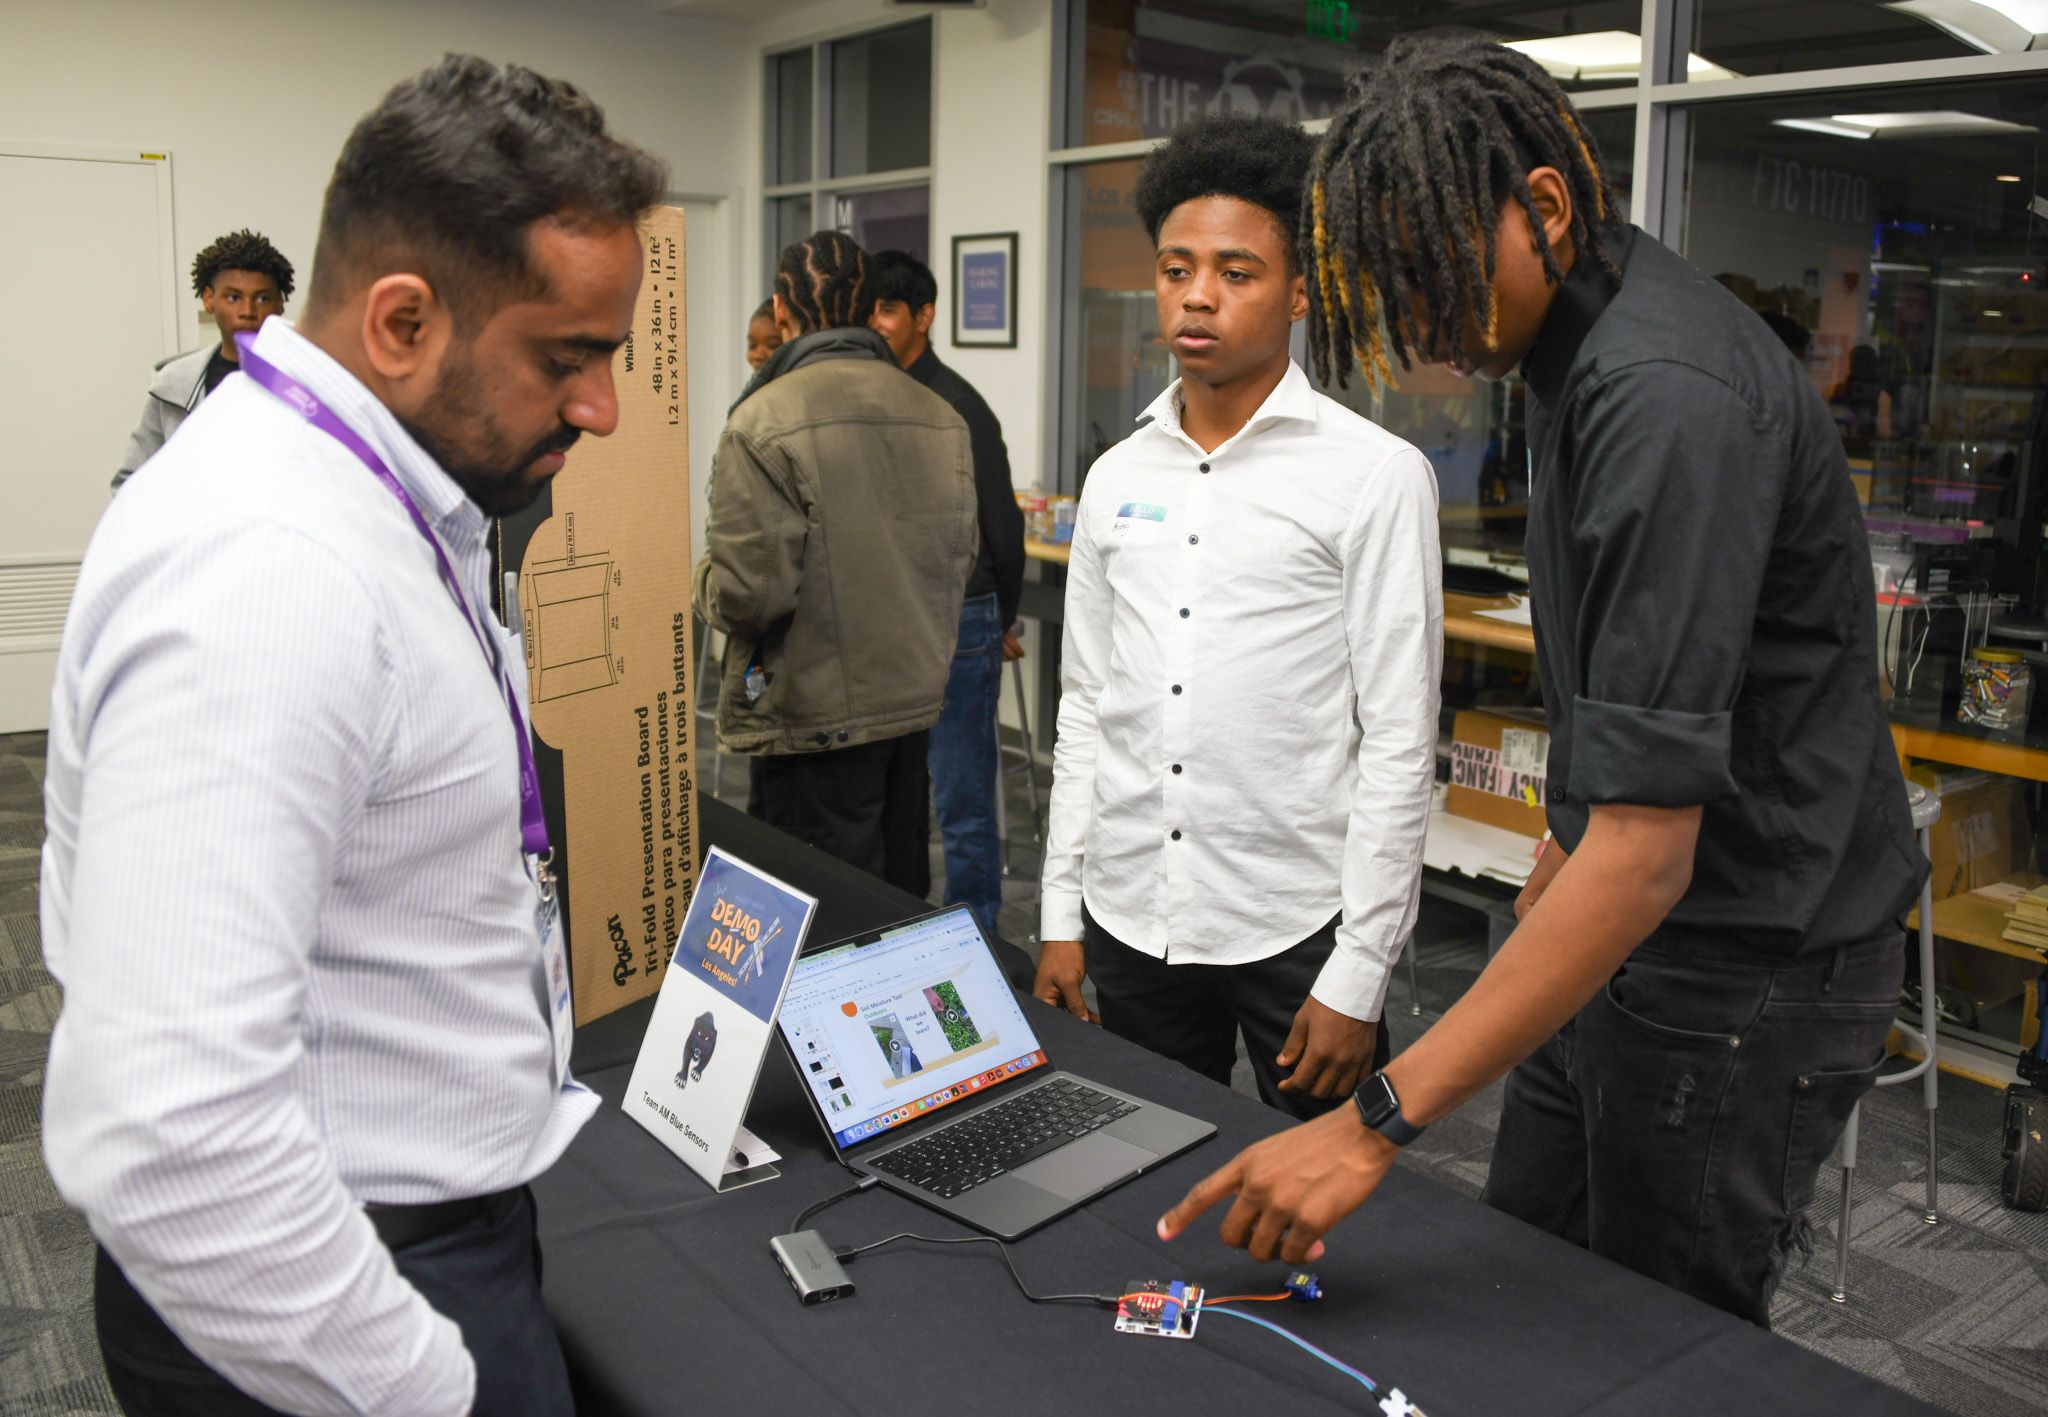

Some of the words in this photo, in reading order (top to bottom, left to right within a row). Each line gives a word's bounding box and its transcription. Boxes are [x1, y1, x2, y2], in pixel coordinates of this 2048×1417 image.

[1141, 72, 1200, 130] THE
[650, 259, 661, 274] 12
[666, 265, 676, 281] 1.1
[652, 299, 661, 313] in
[669, 305, 677, 330] cm
[651, 316, 662, 335] 36
[654, 341, 663, 351] x
[667, 332, 678, 365] 91.4
[653, 355, 663, 371] in
[670, 370, 678, 380] x
[653, 373, 663, 394] 48
[671, 384, 679, 399] m
[669, 405, 679, 425] 1.2
[671, 612, 686, 695] battants
[674, 700, 688, 747] trois
[634, 706, 650, 768] Board
[656, 690, 675, 841] presentaciones
[674, 751, 688, 764] à
[1452, 759, 1497, 792] FANC
[639, 773, 655, 899] Presentation
[661, 846, 677, 890] para
[711, 897, 761, 942] DEMO
[607, 913, 637, 987] Pacon
[642, 903, 658, 977] Tri-Fold
[706, 927, 746, 967] DAY
[701, 958, 713, 971] Los
[870, 999, 892, 1008] Moisture
[892, 993, 903, 1002] Test
[904, 1013, 918, 1023] What
[918, 1010, 927, 1018] did
[643, 1091, 659, 1110] Team
[659, 1105, 670, 1120] AM
[669, 1113, 684, 1132] Blue
[684, 1125, 709, 1152] Sensors
